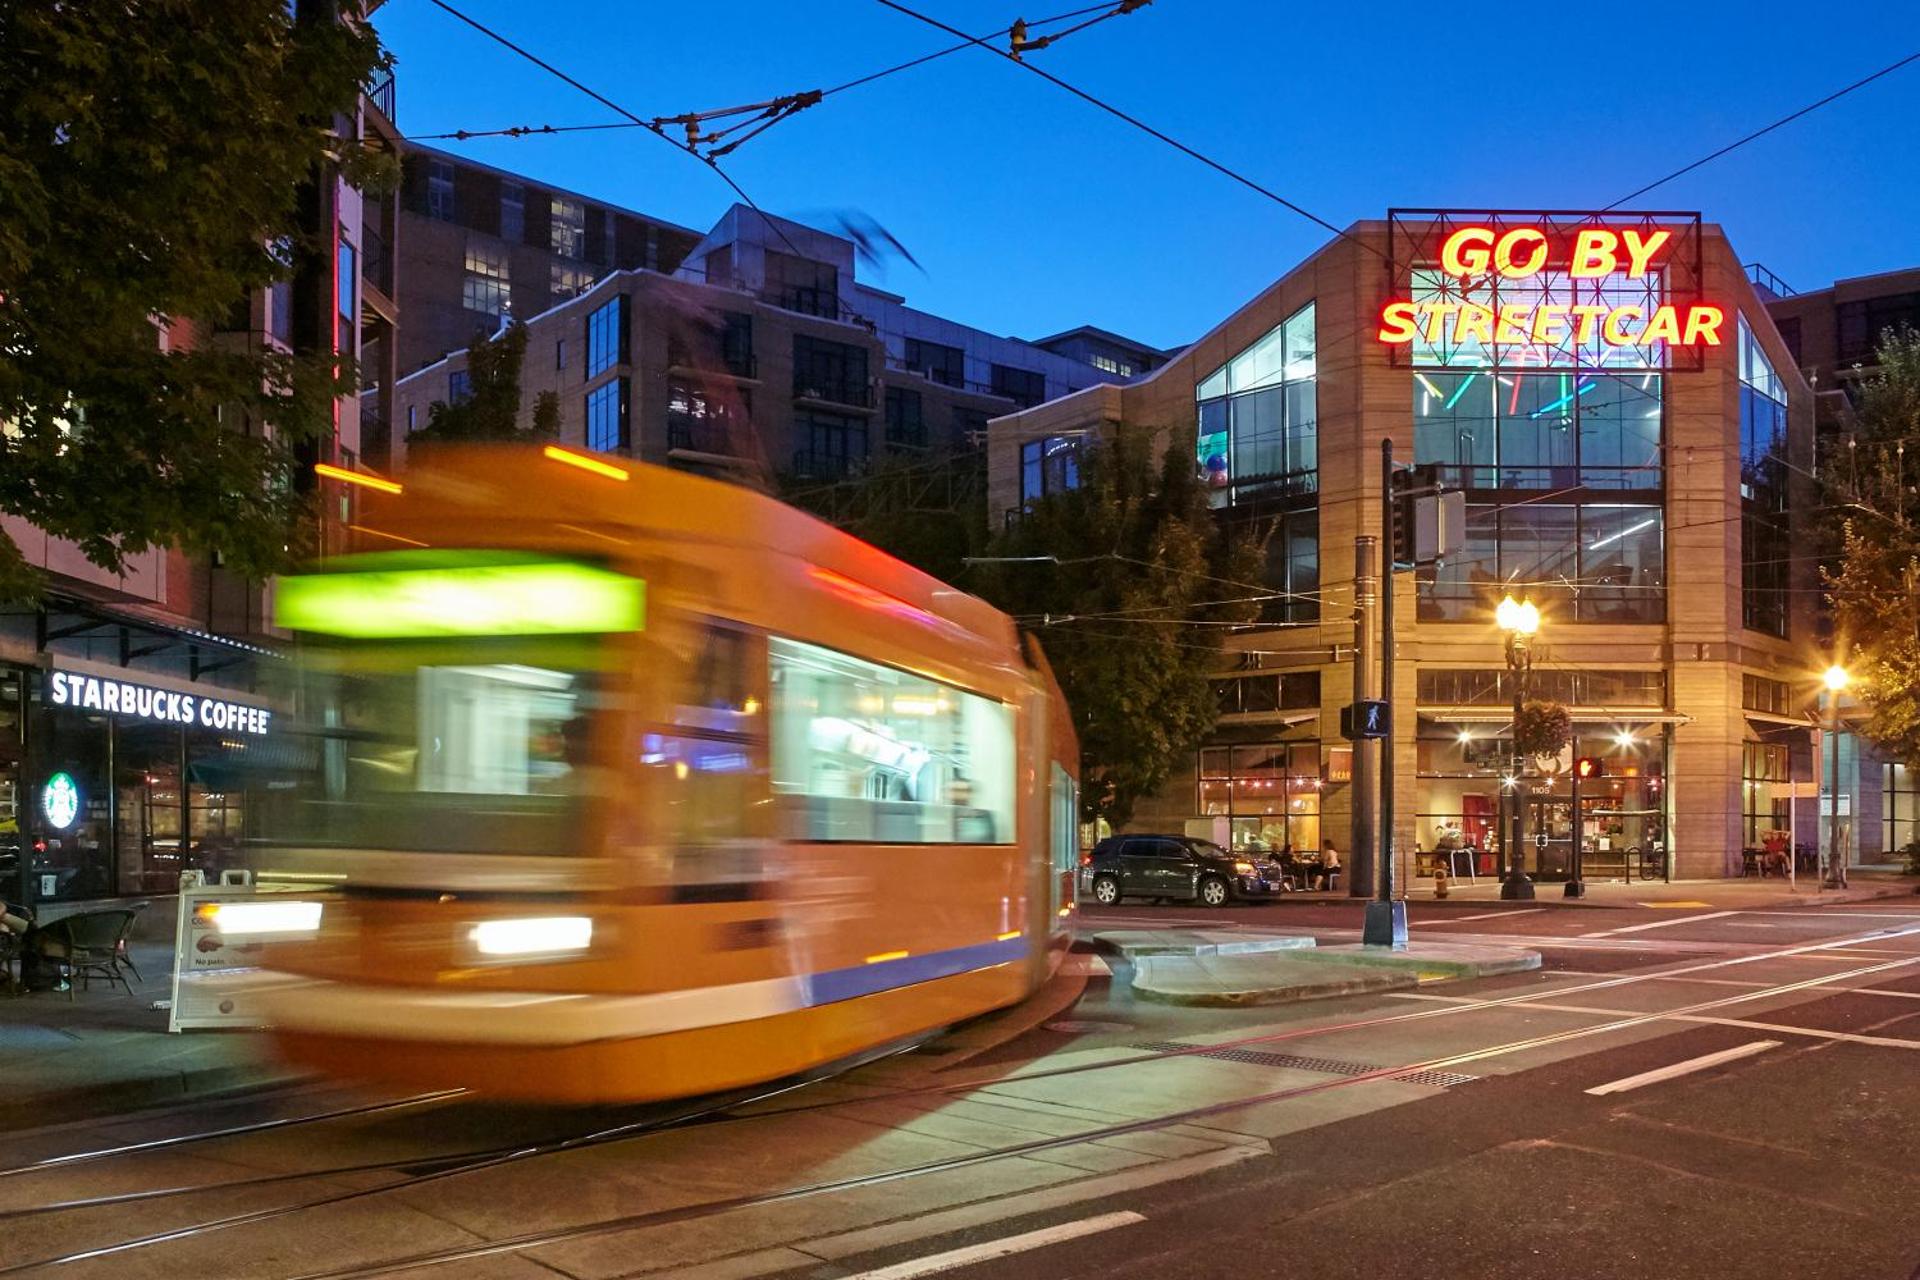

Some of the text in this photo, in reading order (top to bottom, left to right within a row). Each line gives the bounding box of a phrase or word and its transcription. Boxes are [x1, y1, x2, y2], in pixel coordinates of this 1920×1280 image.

[1441, 227, 1671, 281] GO BY
[1377, 302, 1725, 346] STREETCAR
[52, 672, 268, 734] STARBUCKS COFFEE
